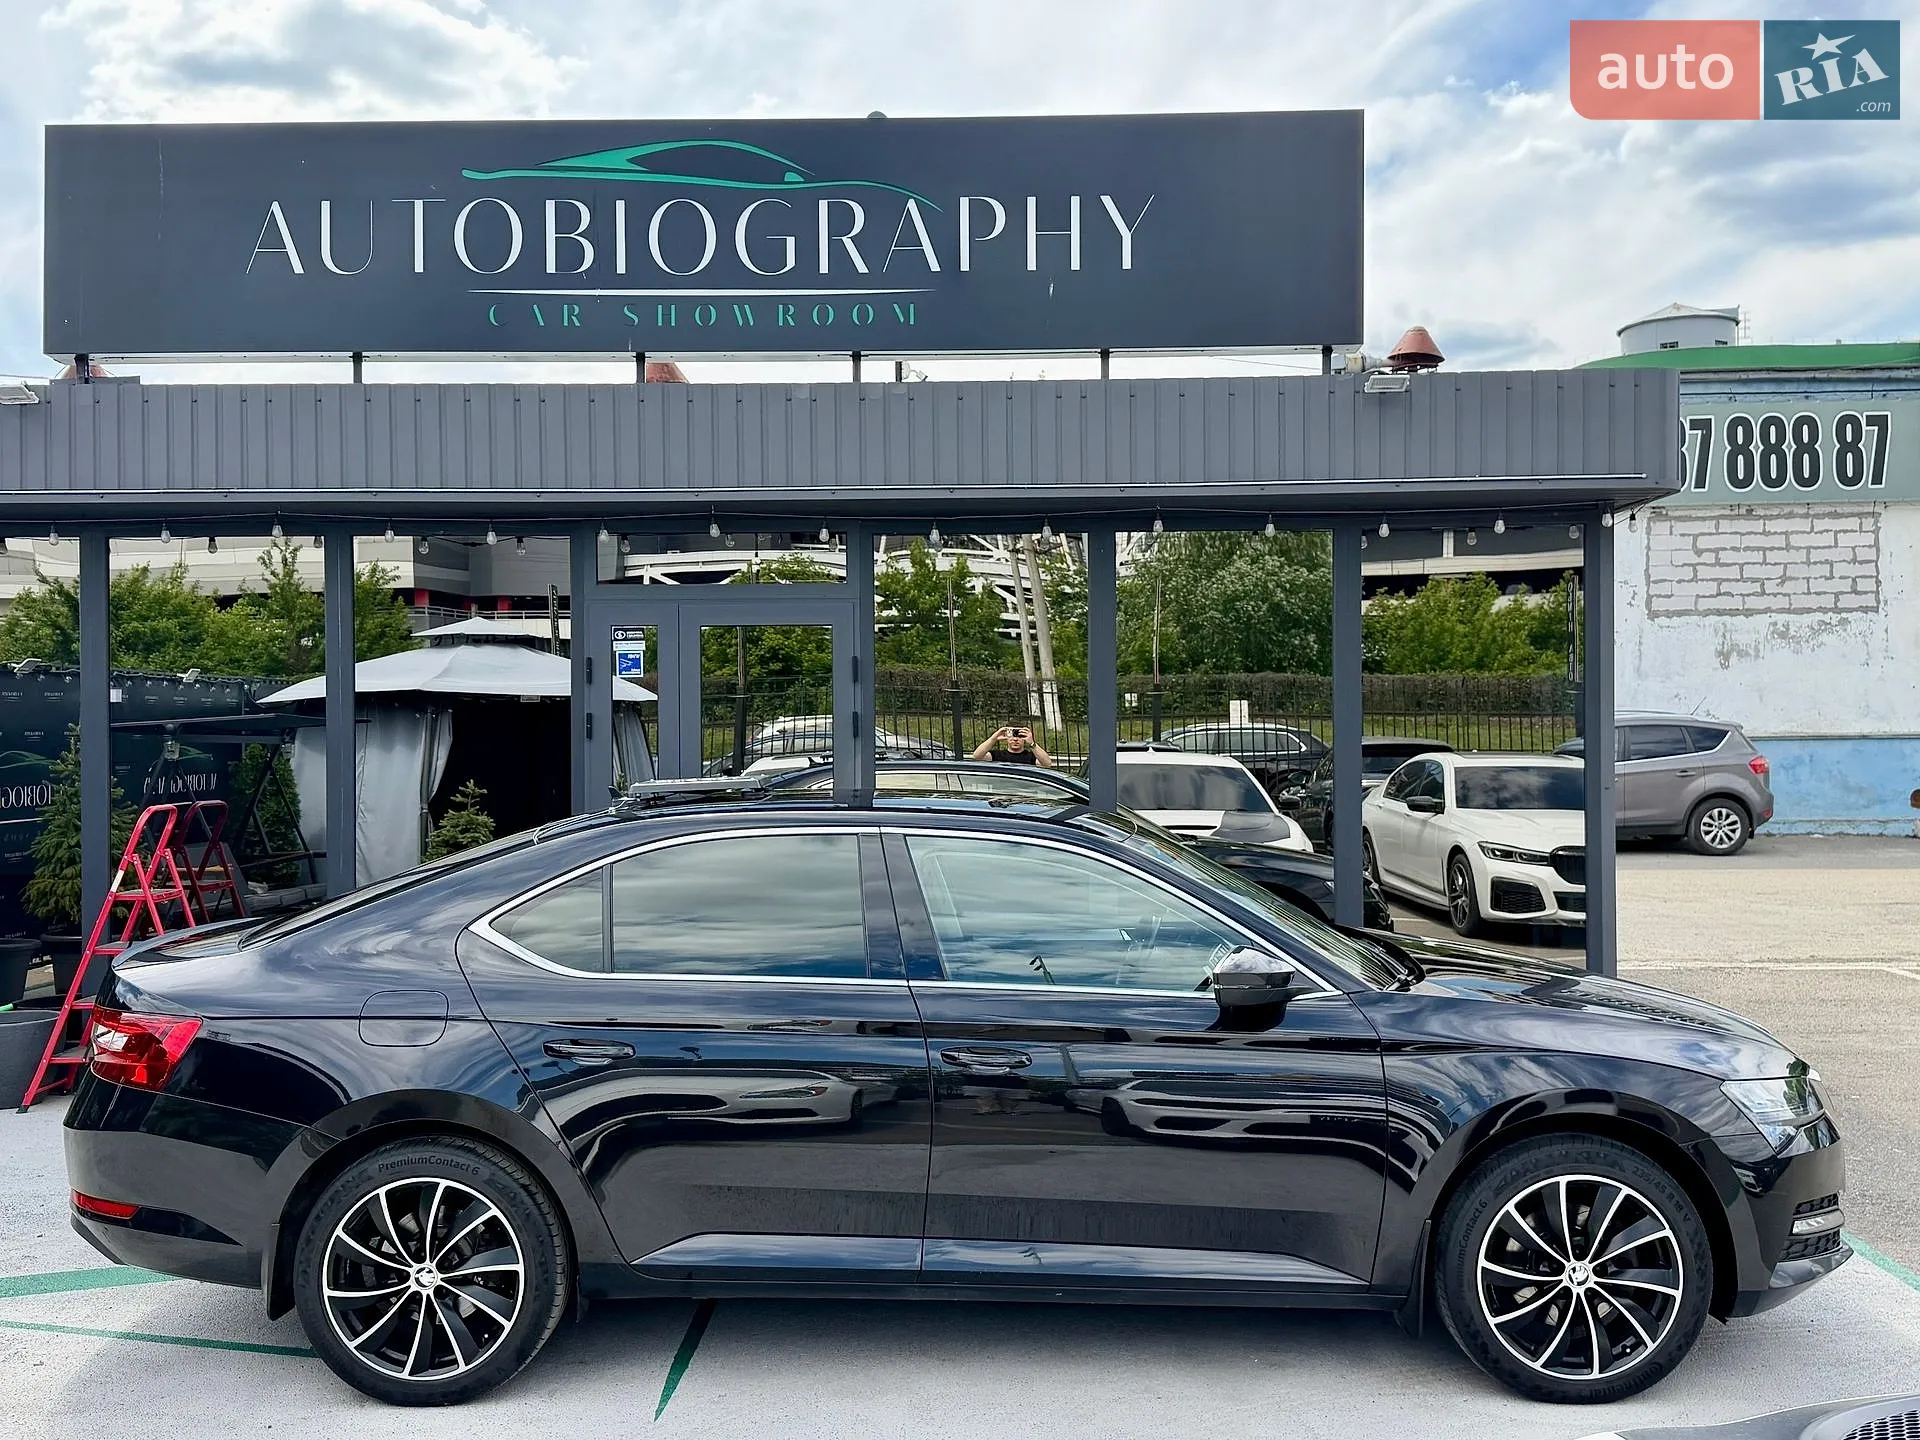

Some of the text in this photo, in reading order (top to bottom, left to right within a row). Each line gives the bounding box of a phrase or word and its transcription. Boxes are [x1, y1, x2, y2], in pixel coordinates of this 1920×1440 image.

[246, 194, 1155, 276] AUTOBIOGRAPHY
[488, 302, 917, 328] CAR SHOWROOM
[1723, 411, 1824, 493] 888
[1832, 410, 1892, 491] 87
[378, 1156, 480, 1176] PremiumContact 6
[1456, 1199, 1488, 1300] miumContact 6
